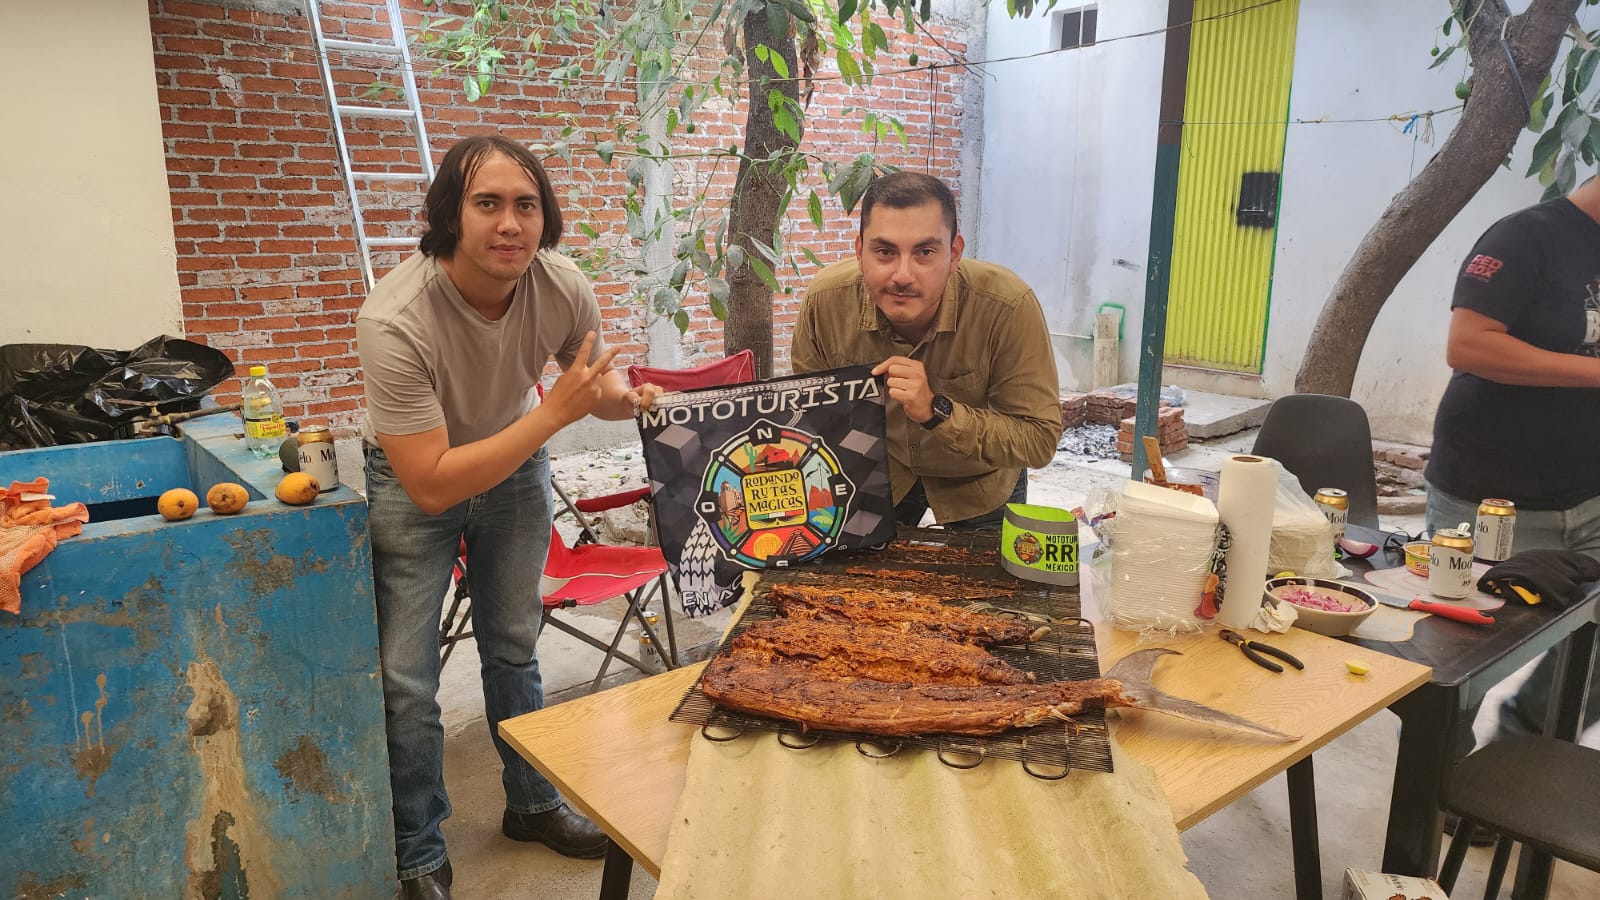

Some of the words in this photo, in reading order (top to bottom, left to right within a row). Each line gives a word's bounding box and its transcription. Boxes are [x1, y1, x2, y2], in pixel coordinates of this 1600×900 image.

[642, 377, 881, 429] MOTOTURISTA
[756, 427, 773, 440] N
[835, 483, 848, 496] E
